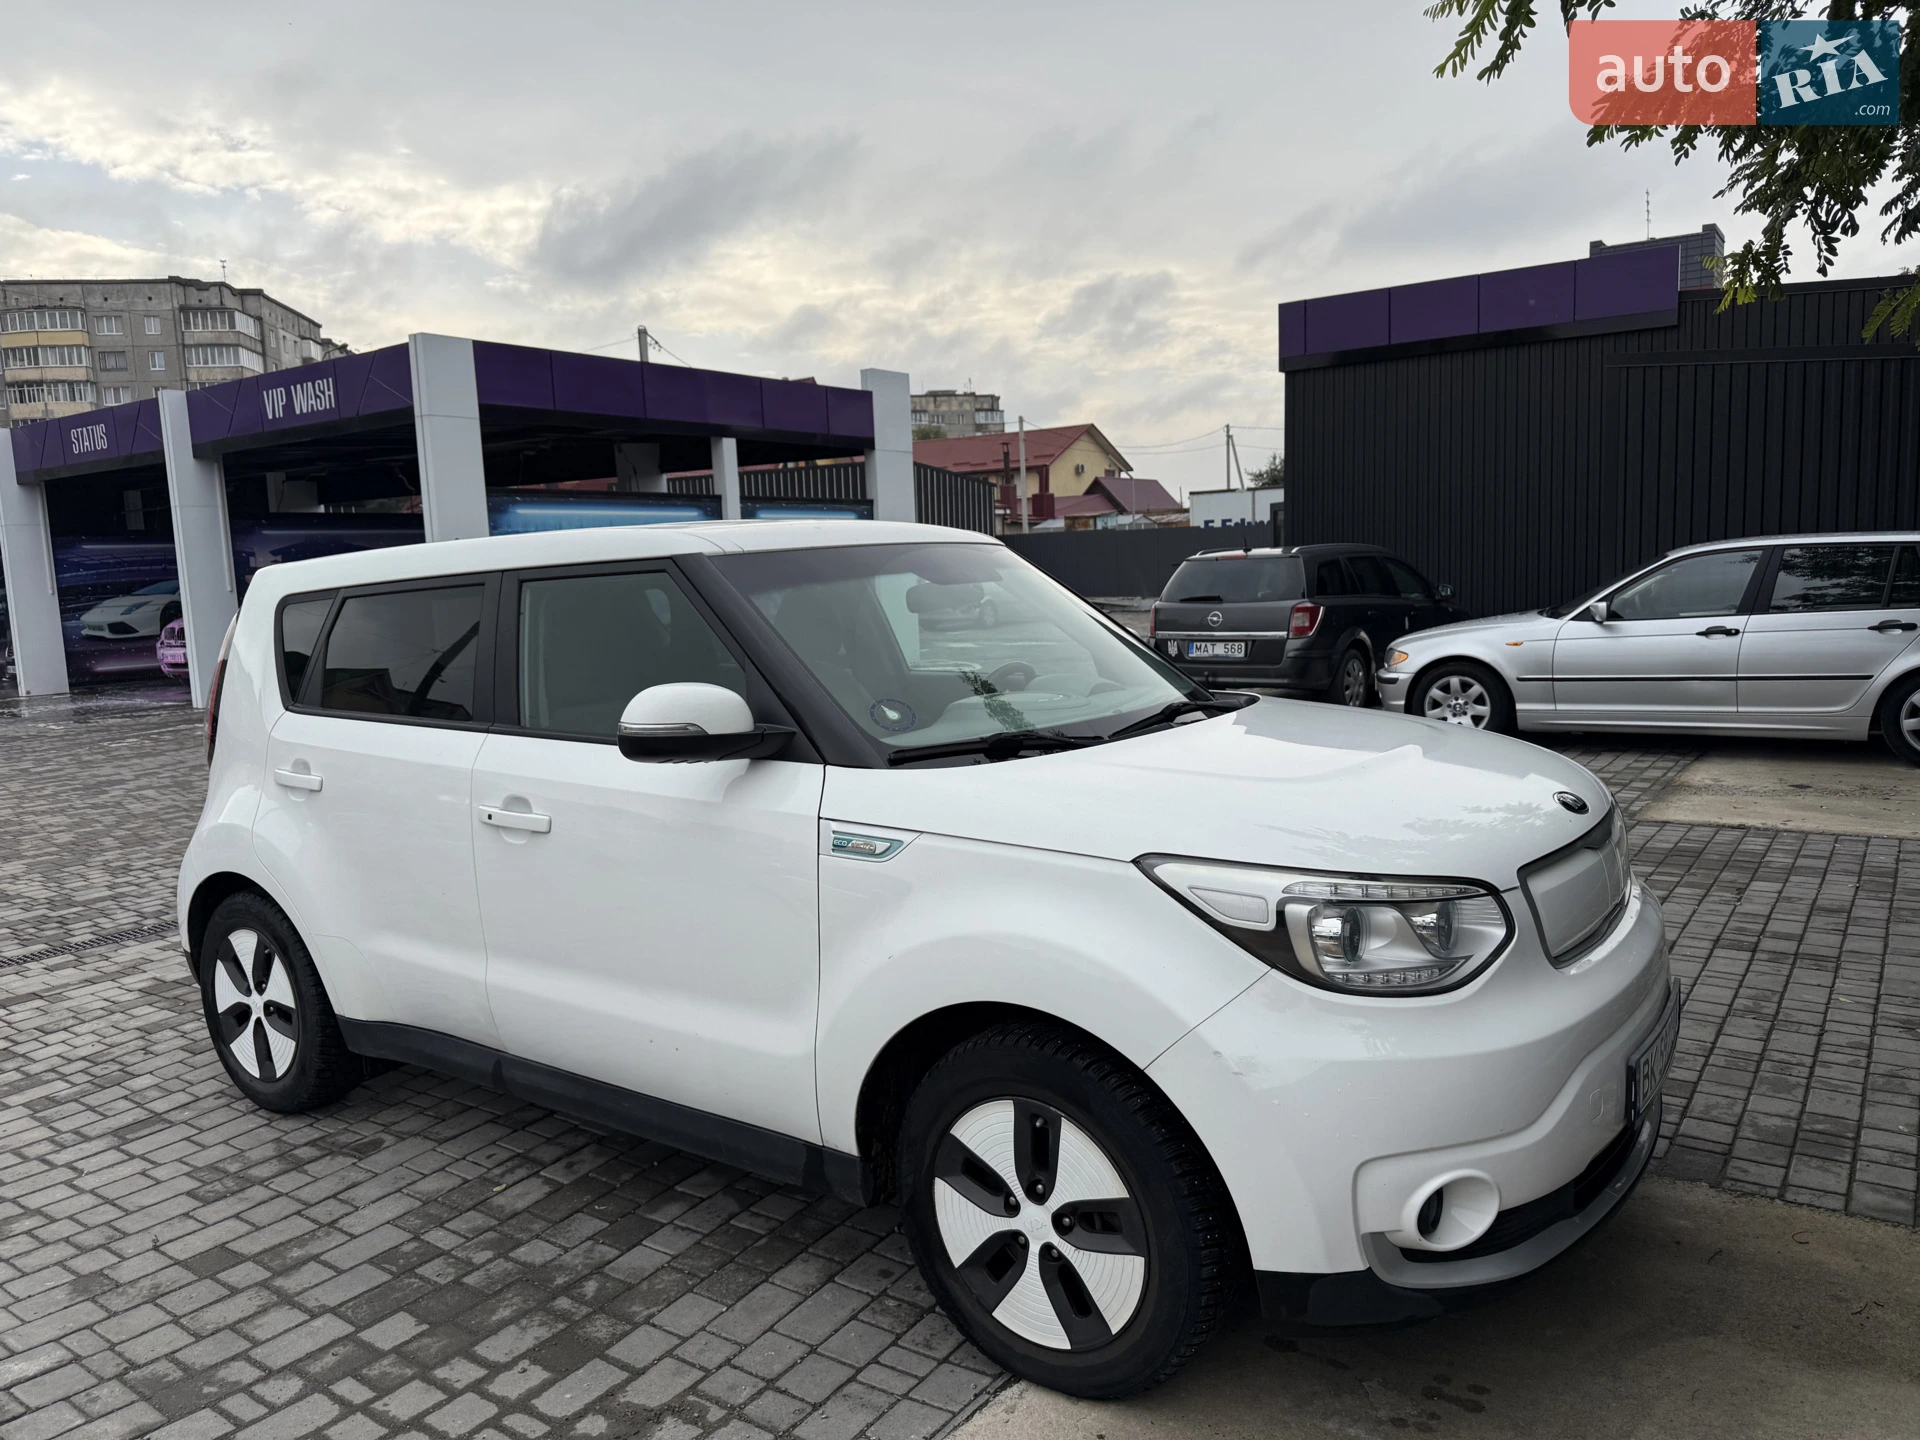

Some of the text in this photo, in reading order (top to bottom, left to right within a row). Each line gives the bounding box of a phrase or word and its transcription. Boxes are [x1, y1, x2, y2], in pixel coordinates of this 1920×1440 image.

[263, 377, 336, 419] VIP WASH
[70, 423, 108, 454] STATUS
[1194, 643, 1243, 654] MAT 568
